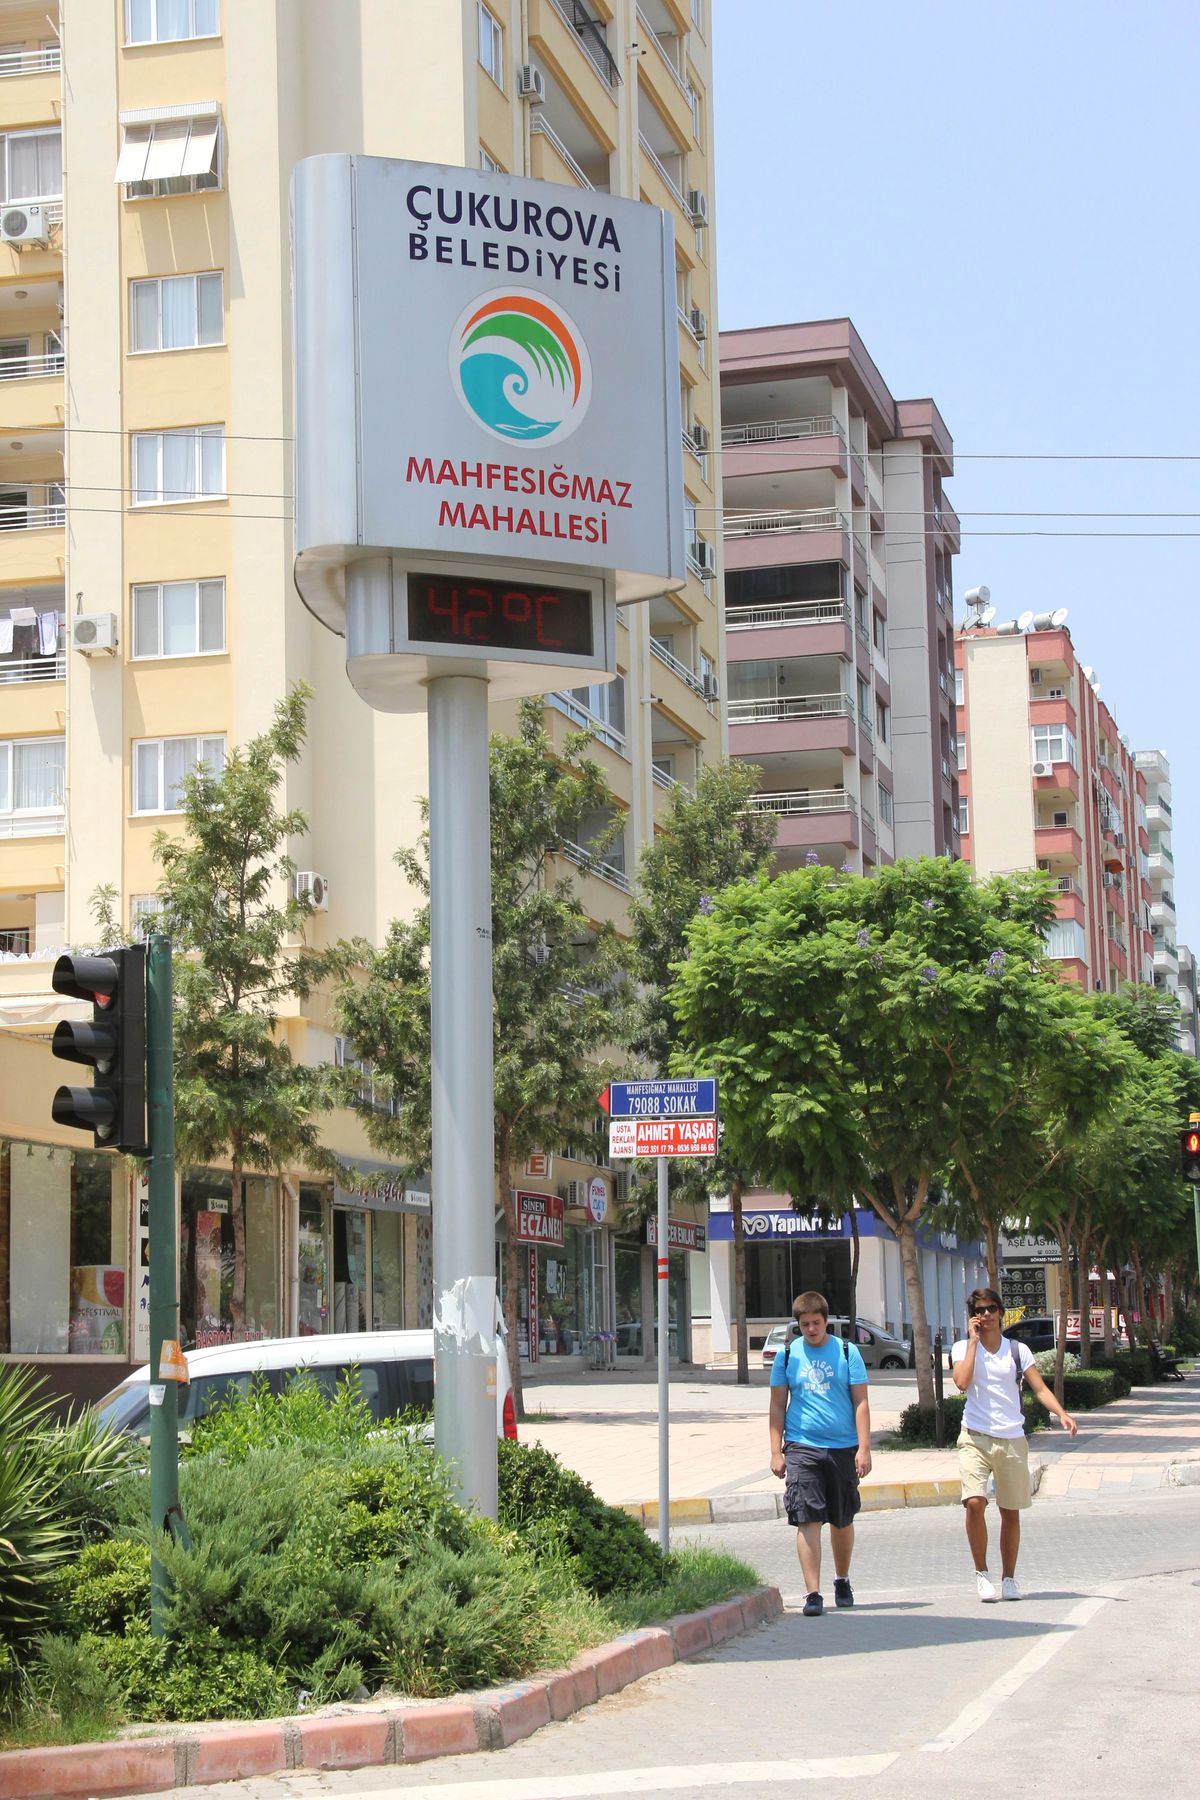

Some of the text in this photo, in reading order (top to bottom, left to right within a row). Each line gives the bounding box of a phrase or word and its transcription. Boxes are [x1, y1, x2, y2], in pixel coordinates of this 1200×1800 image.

[406, 185, 621, 253] ÇUKUROVA
[406, 456, 633, 508] MAHFESIĞMAZ
[438, 500, 608, 544] MAHALLESİ
[628, 1095, 697, 1114] 79088 SOKAK
[616, 1125, 631, 1133] USTA
[637, 1122, 714, 1144] AHMET YAŞAR
[612, 1135, 635, 1144] REKLAM
[530, 1155, 545, 1174] E
[1063, 1317, 1102, 1328] CZNE
